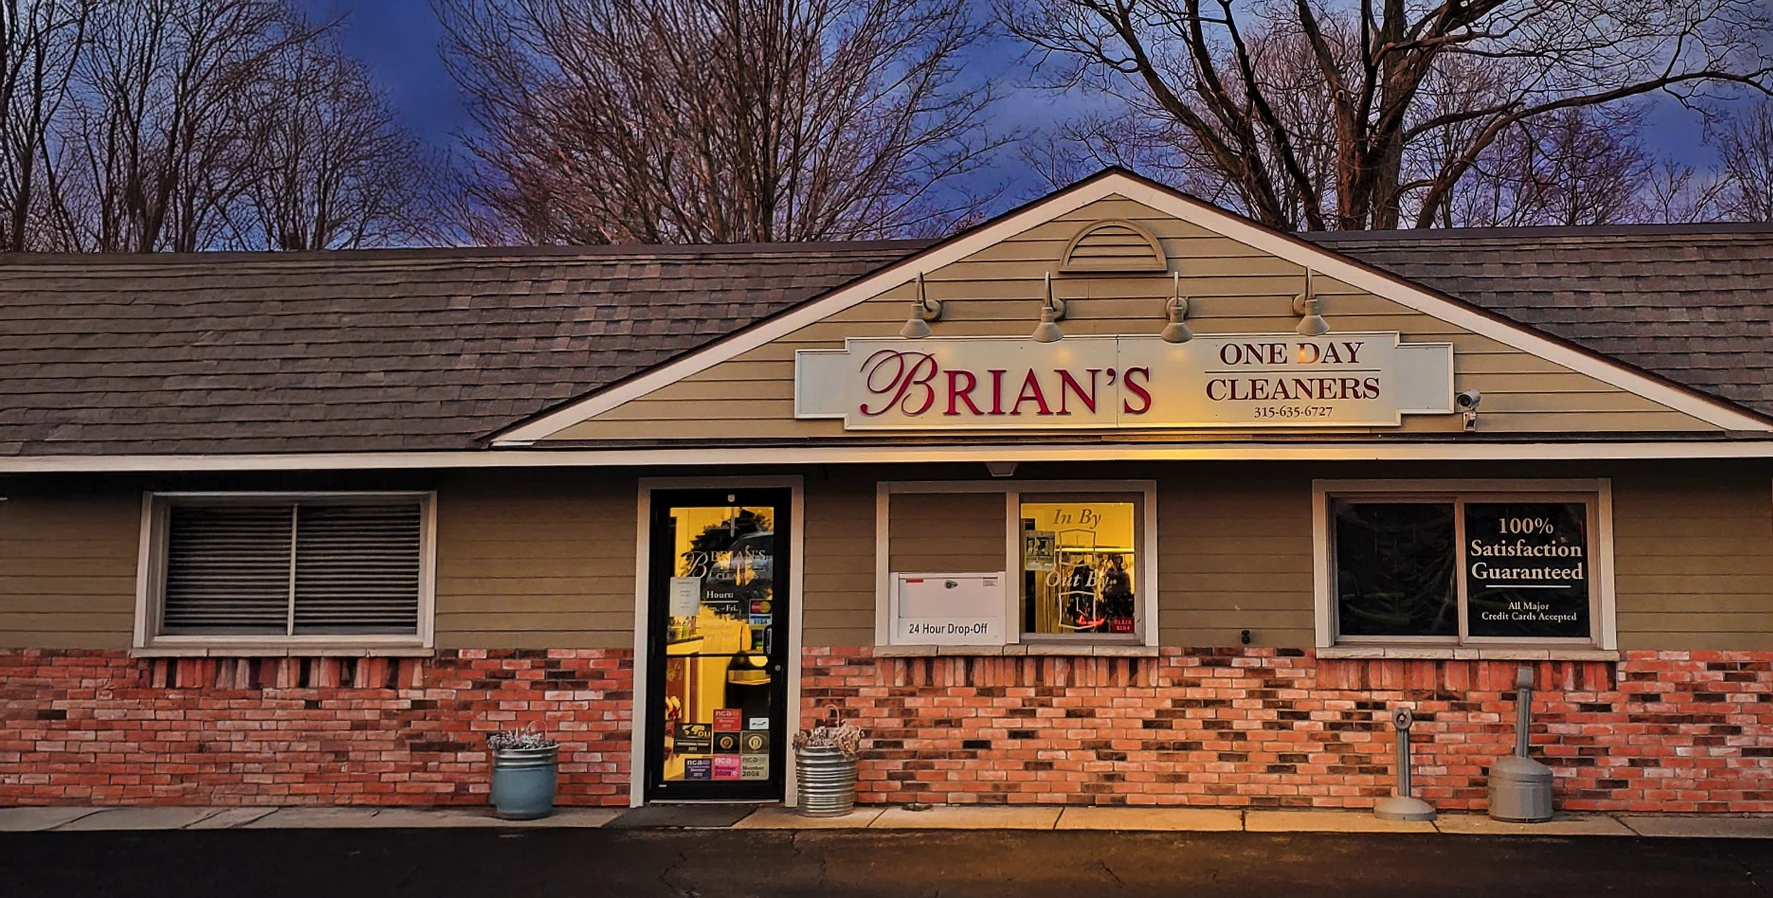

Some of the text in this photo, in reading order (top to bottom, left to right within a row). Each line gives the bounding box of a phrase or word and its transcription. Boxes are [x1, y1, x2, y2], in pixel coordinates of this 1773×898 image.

[1219, 341, 1365, 365] ONE DAY
[860, 349, 1152, 417] BRIAN'S
[1206, 377, 1380, 401] CLEANERS
[1254, 406, 1333, 418] 315-635-6727
[1052, 508, 1102, 529] In By
[1498, 517, 1554, 535] 100%
[1470, 539, 1583, 557] Satisfaction
[1471, 562, 1584, 580] Guaranteed
[1046, 570, 1110, 591] Out By
[706, 590, 734, 599] Hours:
[1508, 602, 1550, 613] All Major
[1481, 612, 1577, 623] Credit Cards Accepted
[909, 623, 988, 636] 24 Hour Drop-Off
[714, 757, 732, 765] nca
